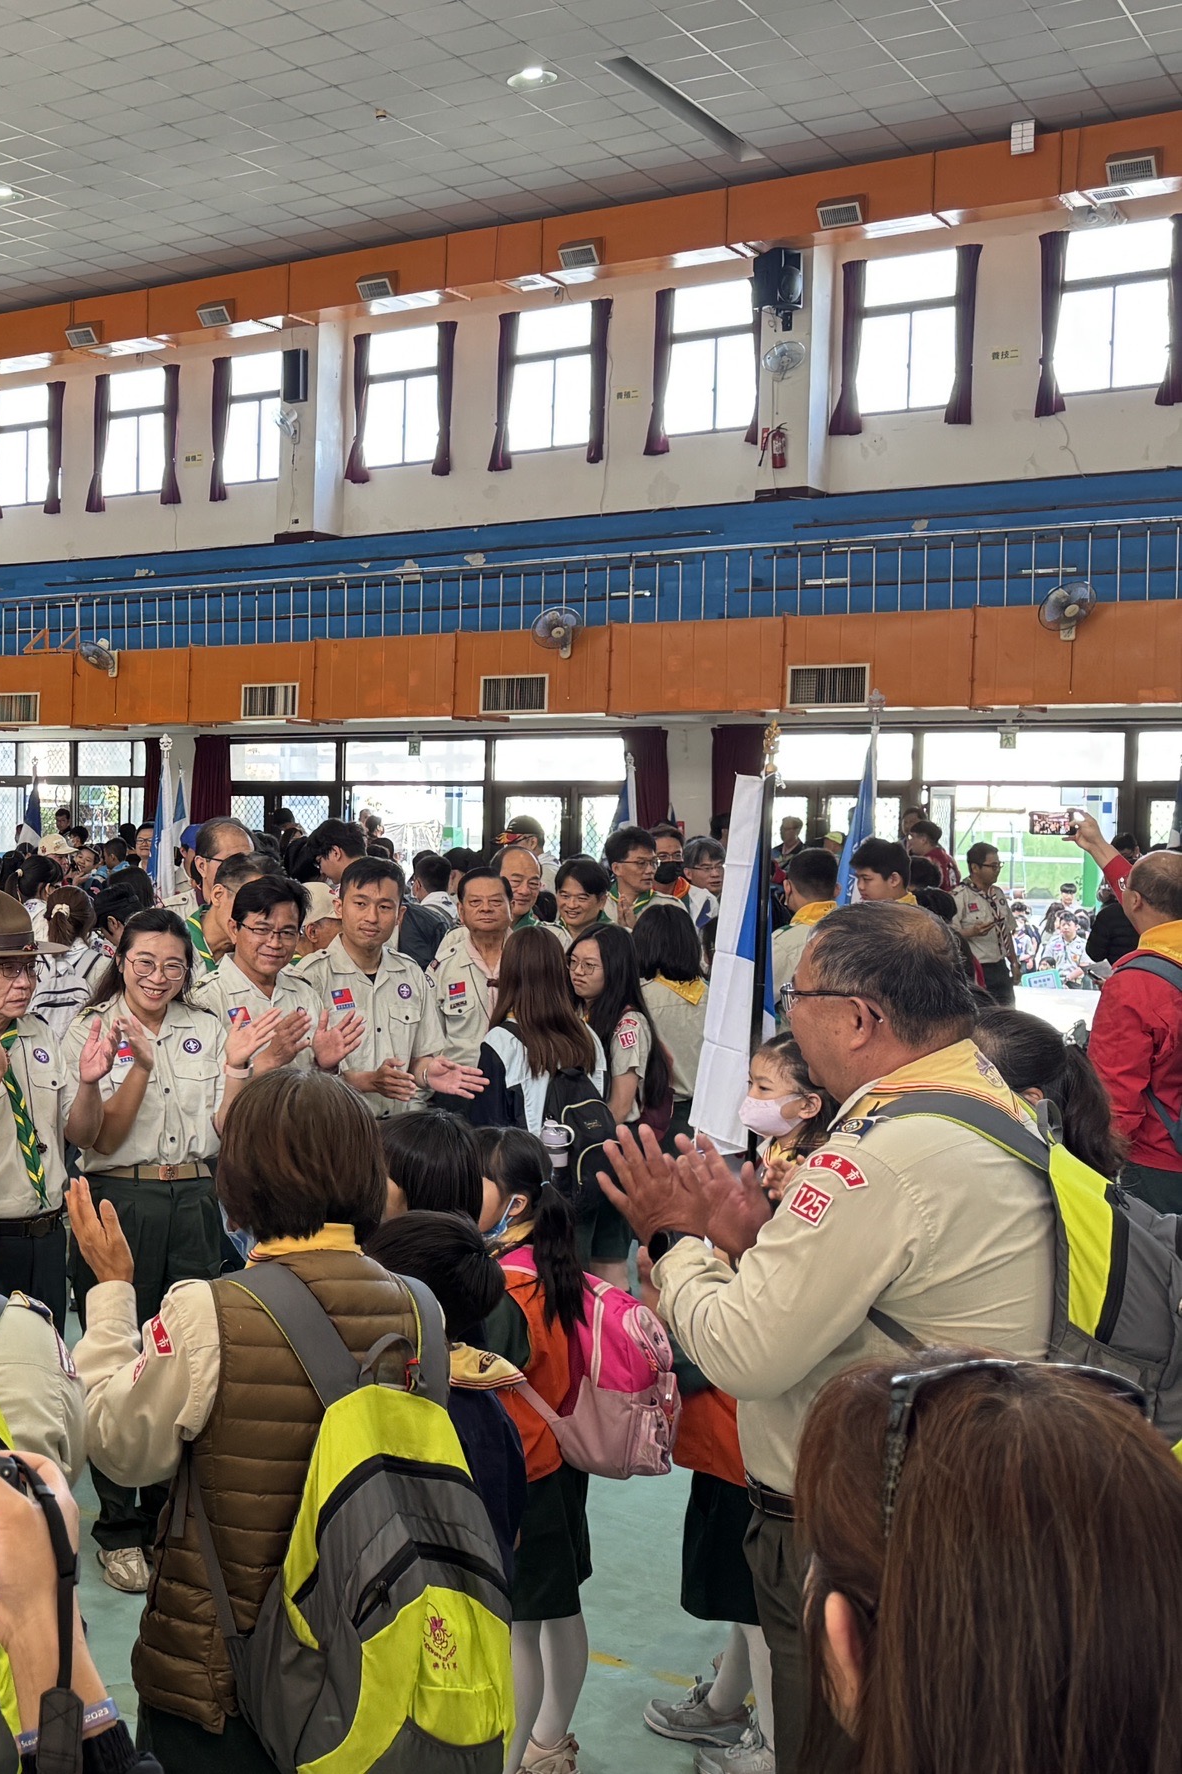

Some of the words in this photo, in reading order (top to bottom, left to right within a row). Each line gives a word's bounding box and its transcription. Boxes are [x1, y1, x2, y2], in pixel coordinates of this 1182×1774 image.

[620, 1032, 634, 1047] 19
[814, 1155, 860, 1181] 台南市
[791, 1186, 828, 1219] 125
[84, 1707, 109, 1723] 2023
